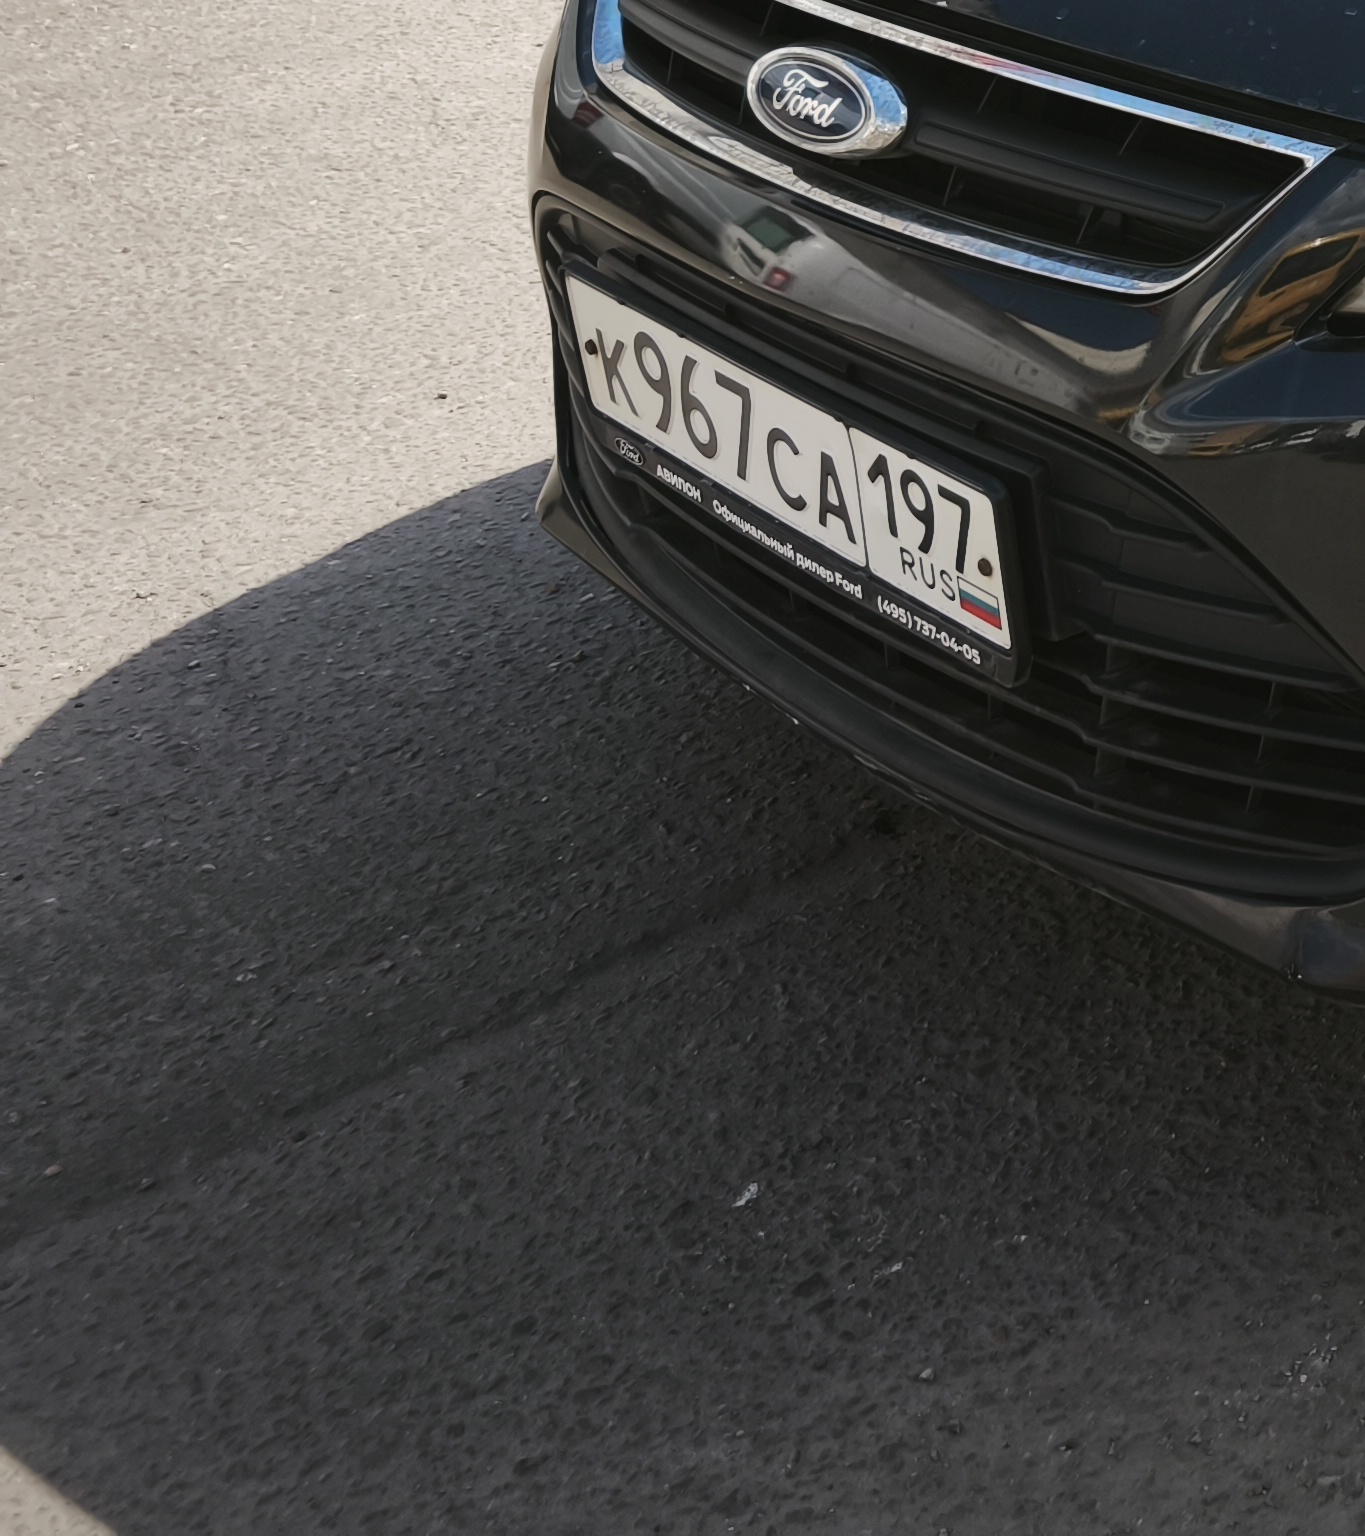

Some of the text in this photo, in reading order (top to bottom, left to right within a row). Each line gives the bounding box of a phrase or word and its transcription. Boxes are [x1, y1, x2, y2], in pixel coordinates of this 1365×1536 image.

[772, 69, 843, 128] Ford
[867, 453, 971, 575] 197
[656, 464, 981, 665] АВИЛОН Официальный дилер Ford (495) 737-04-05
[899, 546, 956, 602] RUS
